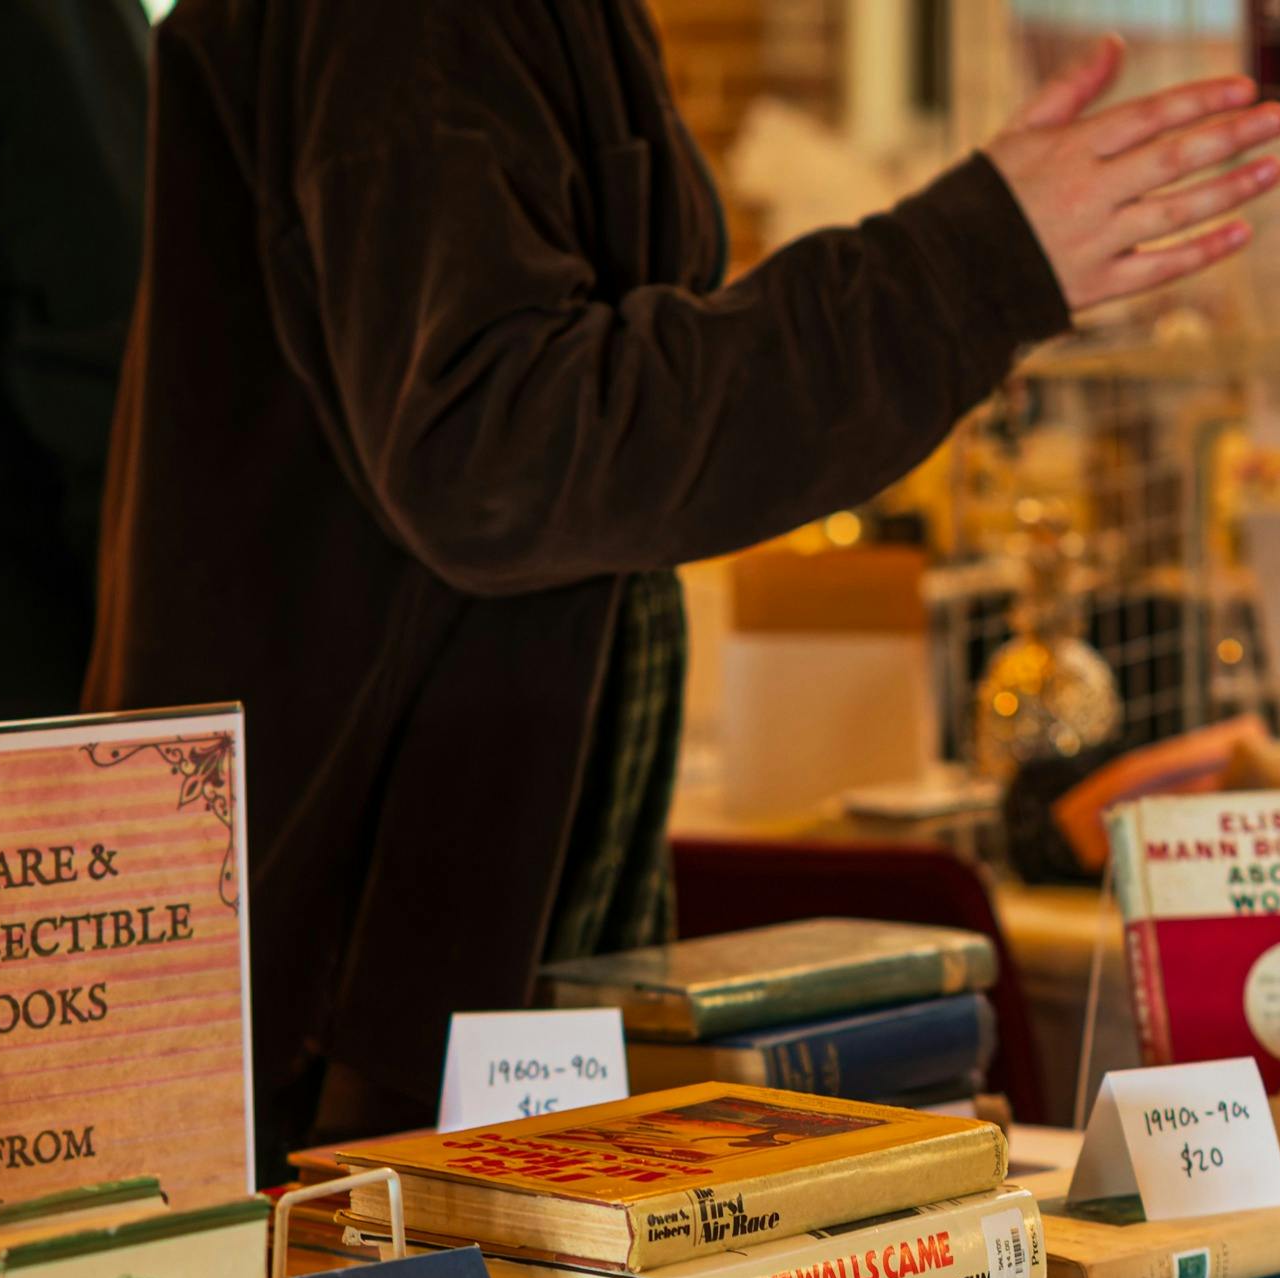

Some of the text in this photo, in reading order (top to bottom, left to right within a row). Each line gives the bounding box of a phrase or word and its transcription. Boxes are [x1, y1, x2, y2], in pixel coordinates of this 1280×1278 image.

[87, 842, 119, 881] &
[1145, 840, 1239, 862] MANN
[1181, 1141, 1224, 1179] $20
[647, 1209, 677, 1229] Owen
[697, 1192, 744, 1221] First
[700, 1211, 780, 1245] Air Race
[1031, 1224, 1039, 1266] Press
